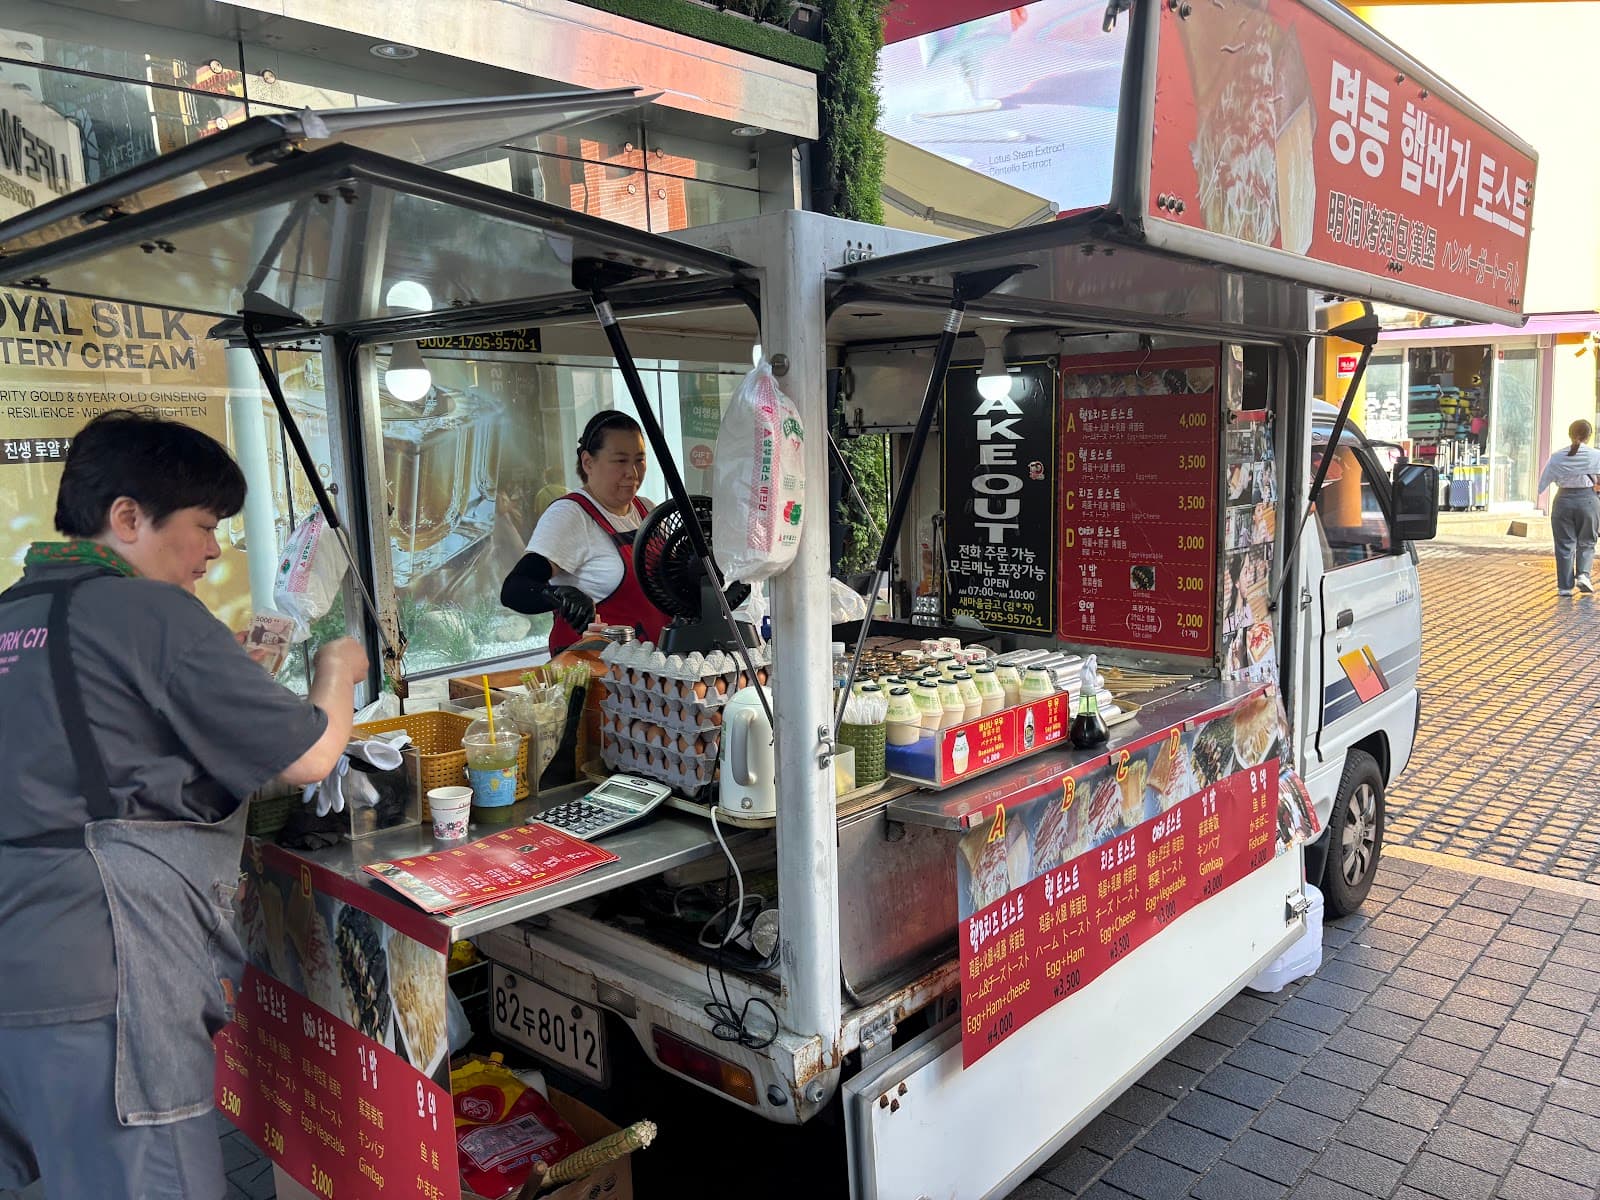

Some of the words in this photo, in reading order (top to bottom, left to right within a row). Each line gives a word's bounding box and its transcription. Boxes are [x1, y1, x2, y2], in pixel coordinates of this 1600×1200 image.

[988, 152, 1011, 165] Lotus
[1012, 148, 1034, 161] Stem
[1035, 142, 1065, 156] Extract
[1329, 59, 1390, 178] 명동
[1400, 102, 1471, 216] 햄버거
[1473, 153, 1529, 238] 토스트
[1022, 158, 1052, 171] Extract
[92, 302, 190, 341] SILK
[81, 342, 196, 370] CREAM
[30, 391, 64, 402] GOLD
[67, 391, 74, 402] &
[119, 392, 147, 402] OLD
[150, 391, 207, 402] GINSENG
[7, 407, 74, 418] RESILIENCE
[1066, 413, 1076, 432] A
[1179, 413, 1206, 429] 4,000
[4, 441, 32, 459] 진생
[35, 442, 61, 458] 로얄
[1078, 447, 1088, 462] 햄
[1090, 449, 1112, 461] 토스트
[1066, 452, 1075, 472] B
[1178, 455, 1206, 470] 3,500
[1066, 490, 1075, 510] C
[1078, 488, 1094, 499] 치즈
[1097, 488, 1120, 499] 토스트
[1178, 496, 1205, 511] 3,500
[1066, 528, 1075, 548] D
[1097, 526, 1120, 538] 토스트
[1178, 536, 1204, 550] 3,000
[959, 544, 981, 559] 전화
[984, 546, 1009, 561] 주문
[1011, 547, 1036, 564] 가능
[949, 559, 995, 577] 모든메뉴
[997, 562, 1047, 581] 포장가능
[983, 577, 1009, 588] OPEN
[1177, 576, 1203, 591] 3,000
[960, 596, 1001, 610] 새마을금고
[1009, 590, 1035, 600] 10:00
[1177, 613, 1203, 628] 2,000
[1169, 728, 1181, 760] D
[1116, 749, 1130, 782] C
[1061, 776, 1076, 811] B
[988, 803, 1006, 843] A
[1165, 807, 1182, 837] 토스트
[1100, 847, 1115, 872] 치즈
[1116, 834, 1136, 866] 토스트
[1199, 855, 1224, 876] Gimbap
[1044, 873, 1054, 907] 햄
[1056, 864, 1080, 899] 토스트
[1145, 874, 1187, 912] Egg+Vegetable
[1001, 893, 1024, 931] 토스트
[1035, 935, 1060, 959] ハーム
[1063, 915, 1091, 944] トースト
[1100, 909, 1137, 945] Egg+Cheese
[1045, 945, 1085, 979] Egg+Ham
[967, 977, 1031, 1034] Egg+Ham+cheese
[317, 1016, 337, 1056] 토스트
[220, 1086, 241, 1117] 3,500
[263, 1122, 285, 1155] 3,500
[300, 1110, 346, 1157] Egg+Vegetable
[311, 1163, 333, 1199] 3,000
[358, 1156, 385, 1191] Gimbap
